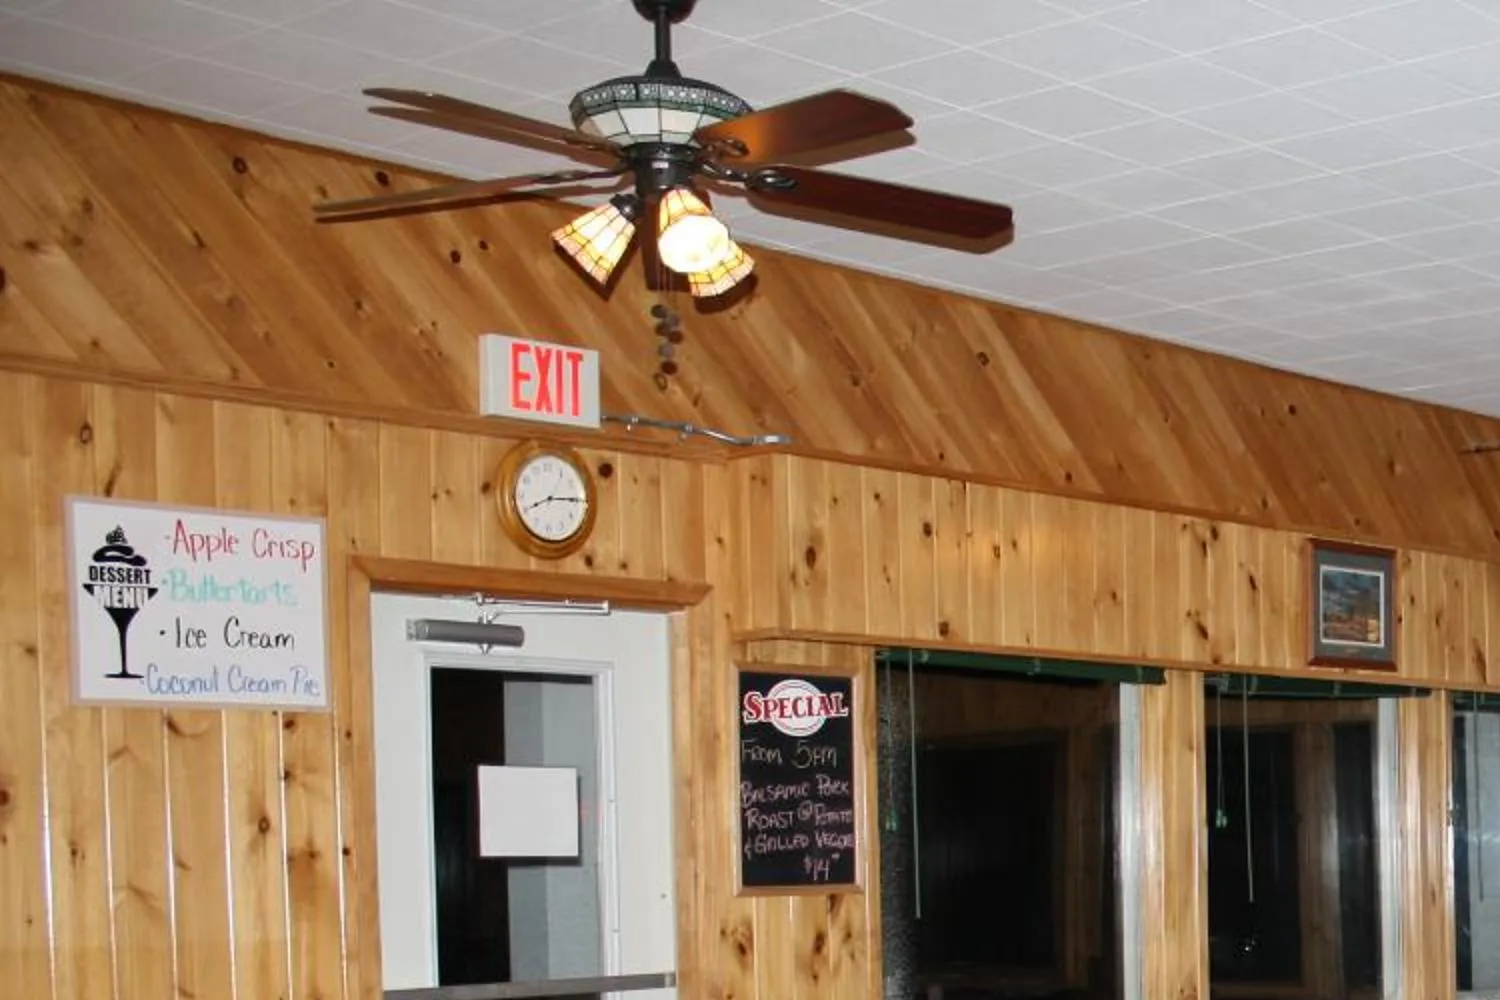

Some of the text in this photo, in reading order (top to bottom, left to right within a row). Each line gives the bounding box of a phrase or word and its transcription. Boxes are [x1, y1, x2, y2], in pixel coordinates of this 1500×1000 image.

[511, 343, 584, 416] EXIT
[172, 519, 316, 572] Apple Crisp
[89, 565, 151, 584] DESSERT
[94, 584, 149, 609] MENU
[175, 615, 295, 651] Ice Cream
[146, 662, 321, 697] Coconut Cream Pie
[744, 692, 848, 723] SPECIAL
[744, 807, 794, 830] ROAST
